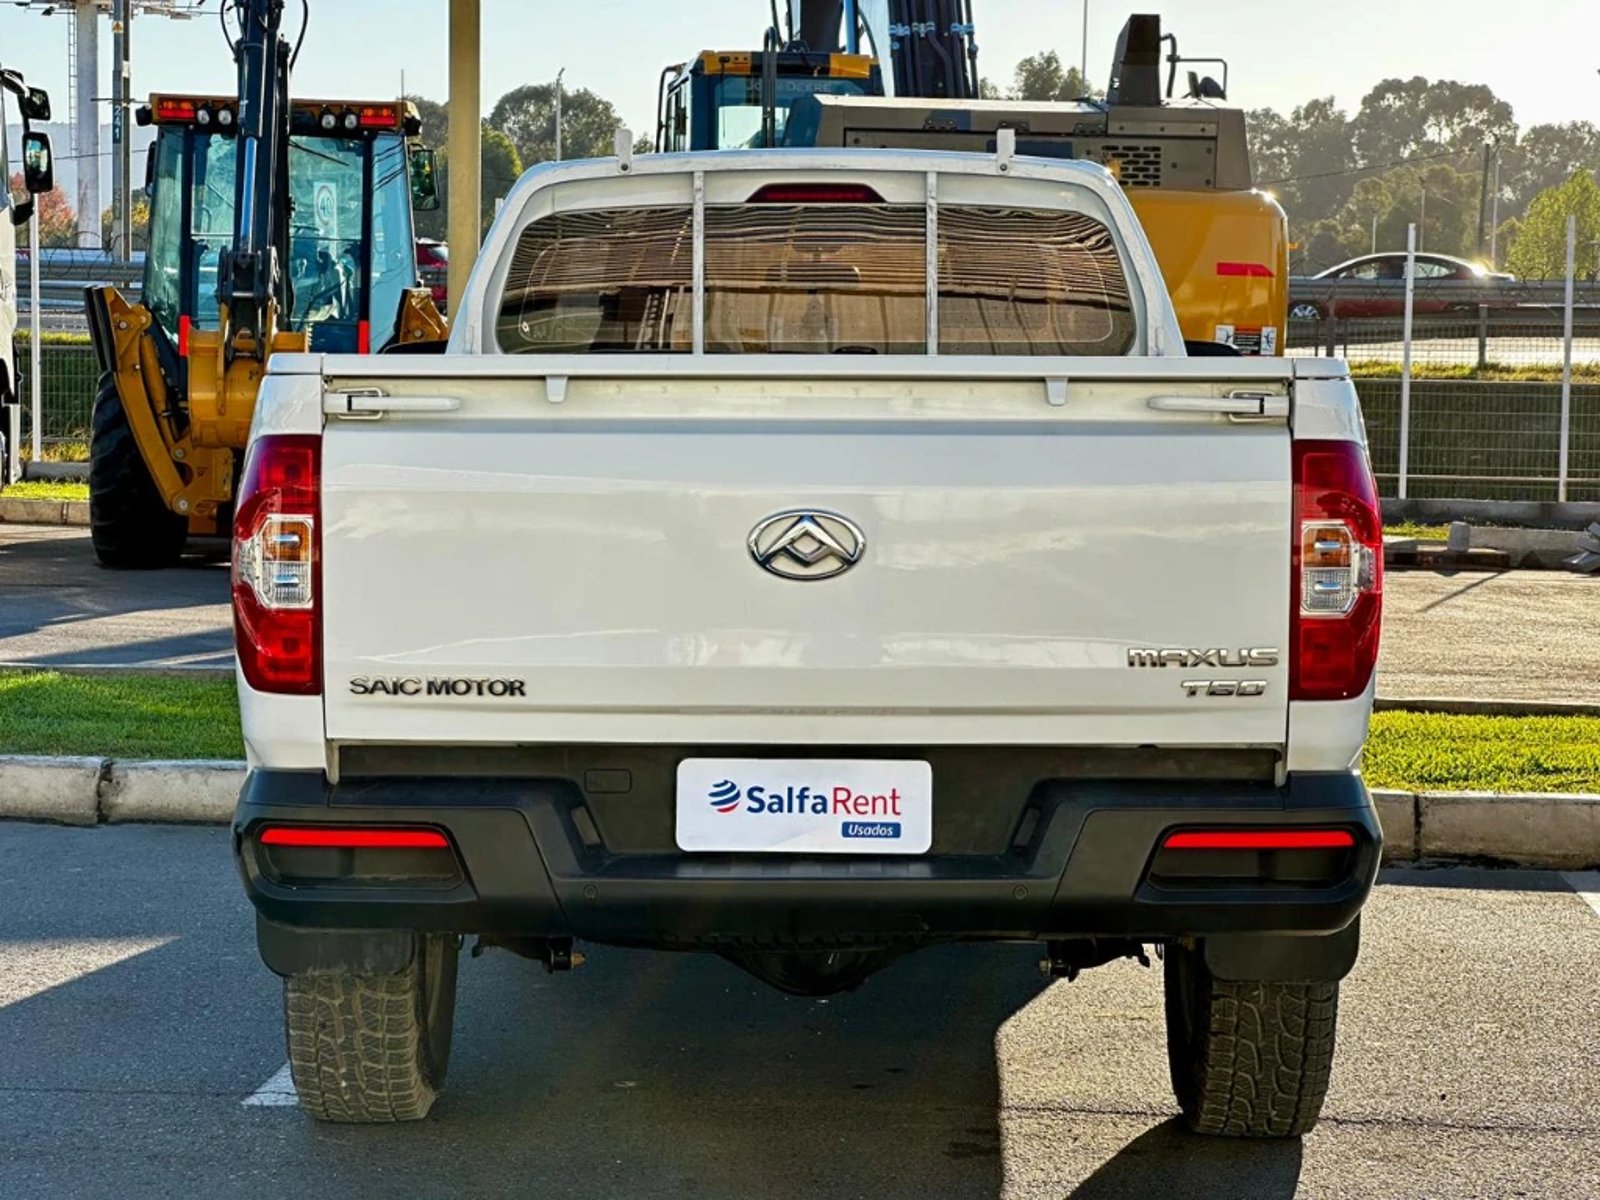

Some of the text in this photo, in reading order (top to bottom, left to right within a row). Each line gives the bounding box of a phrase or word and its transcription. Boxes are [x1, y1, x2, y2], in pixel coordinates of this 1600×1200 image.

[786, 80, 832, 92] DEERE
[1128, 648, 1279, 668] MAXUS
[349, 675, 527, 697] SAIC MOTOR
[1181, 680, 1268, 697] T60
[746, 785, 902, 815] SalfaRent
[847, 823, 894, 836] Usados
